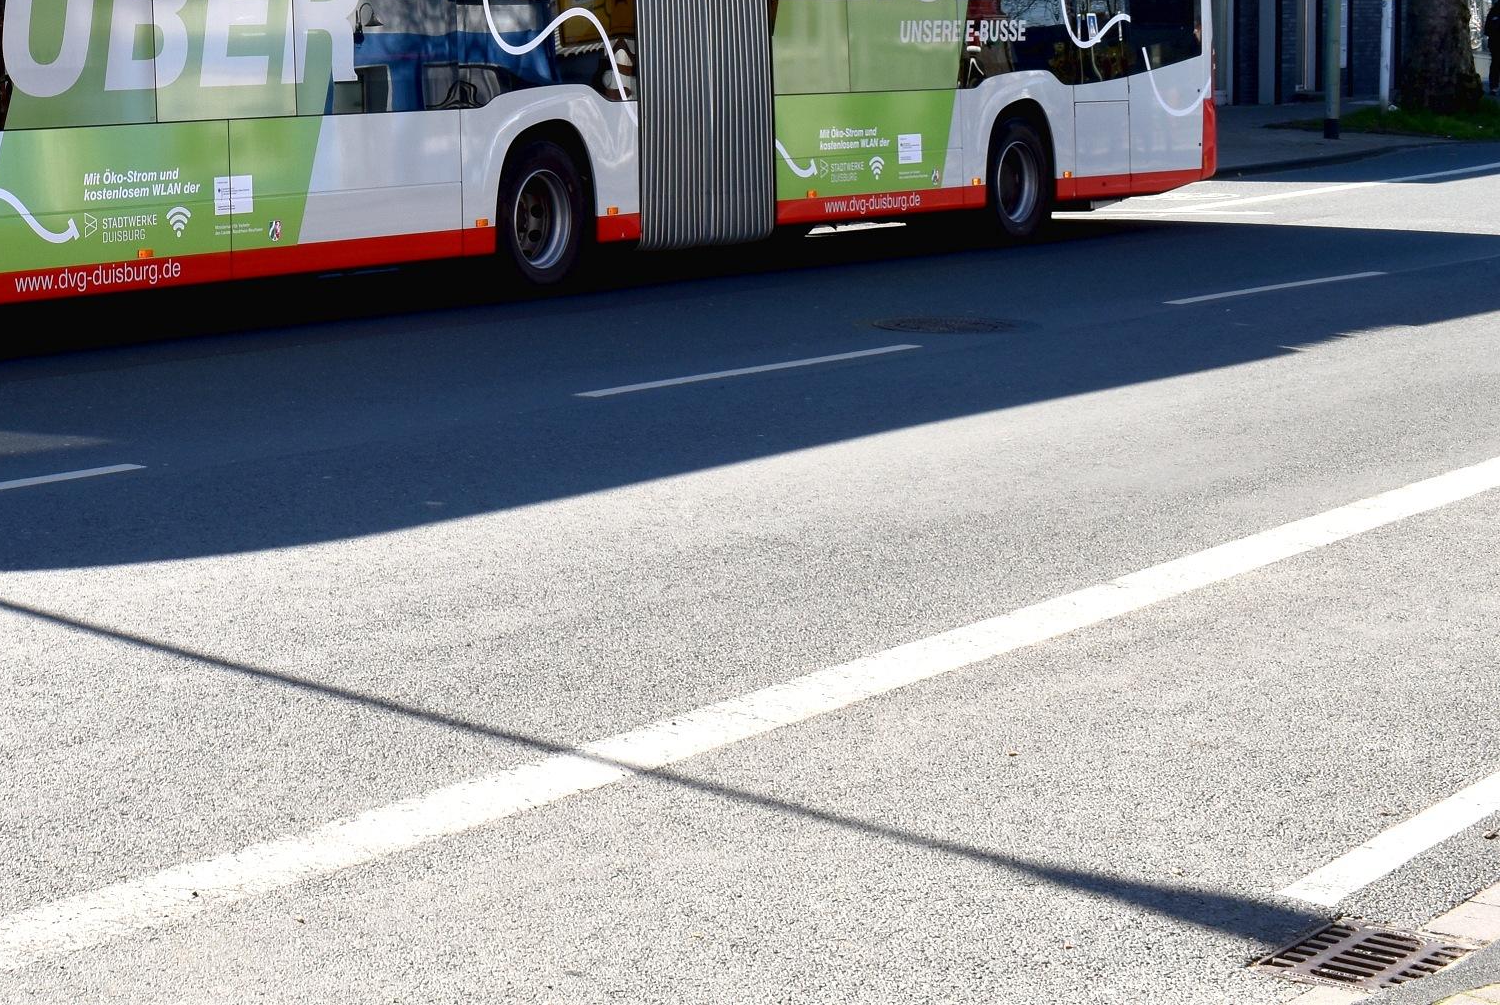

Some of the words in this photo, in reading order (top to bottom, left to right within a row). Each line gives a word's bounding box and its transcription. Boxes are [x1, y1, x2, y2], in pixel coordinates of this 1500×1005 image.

[900, 19, 961, 44] UNSERE
[965, 19, 1027, 43] E-BUSSE
[819, 127, 830, 139] Mit
[831, 126, 864, 138] Öko-Strom
[865, 127, 877, 136] und
[819, 139, 860, 150] kostenlosem
[860, 138, 879, 148] WLAN
[879, 138, 891, 147] der
[830, 161, 865, 173] STADTWERKE
[83, 171, 100, 186] Mit
[103, 168, 157, 185] Öko-Strom
[159, 167, 180, 181] und
[83, 186, 150, 202] kostenlosem
[152, 183, 181, 197] WLAN
[183, 182, 200, 194] der
[824, 191, 921, 215] www.dvg-duisburg.de
[102, 213, 158, 230] STADTWERKE
[102, 228, 146, 244] DUISBURG
[14, 258, 182, 293] www.dvg-duisburg.de
